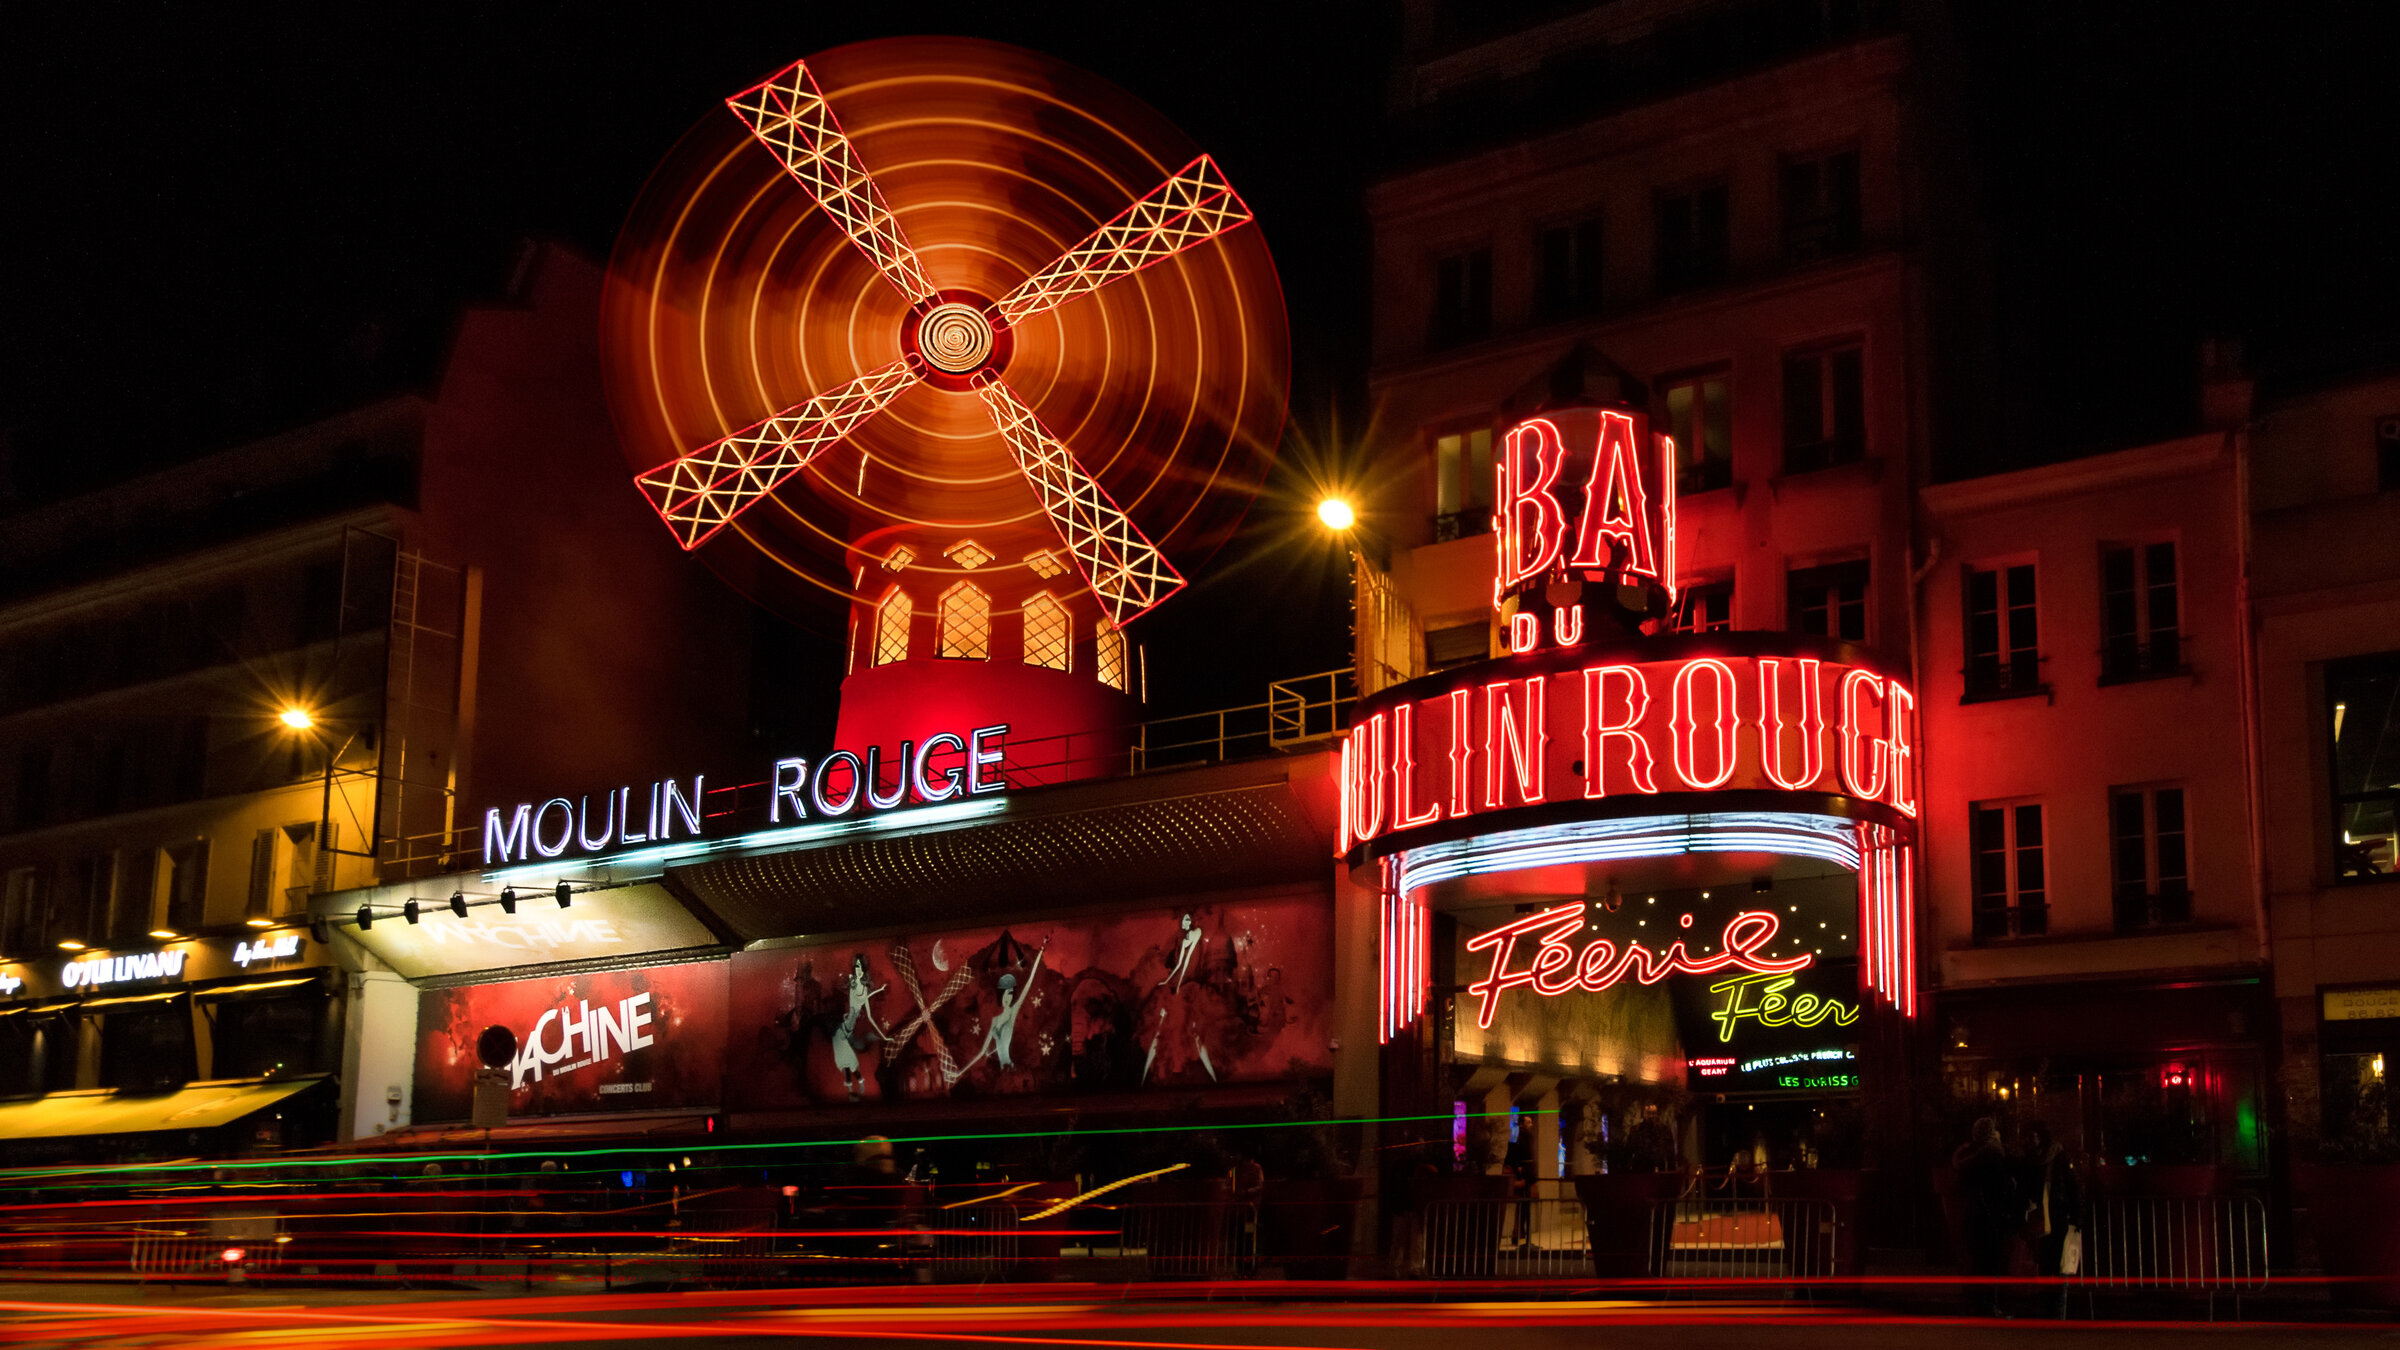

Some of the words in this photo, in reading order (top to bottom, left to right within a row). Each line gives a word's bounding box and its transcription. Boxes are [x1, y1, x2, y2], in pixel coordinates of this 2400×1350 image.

[1504, 411, 1676, 606] BA
[1511, 604, 1583, 653] DU
[482, 774, 704, 865] MOULIN
[770, 724, 1008, 823] ROUGE
[1341, 676, 1548, 853] ULIN
[1582, 657, 1917, 818] ROUGE
[1466, 900, 1813, 1029] Féerie
[1778, 1076, 1800, 1087] LES
